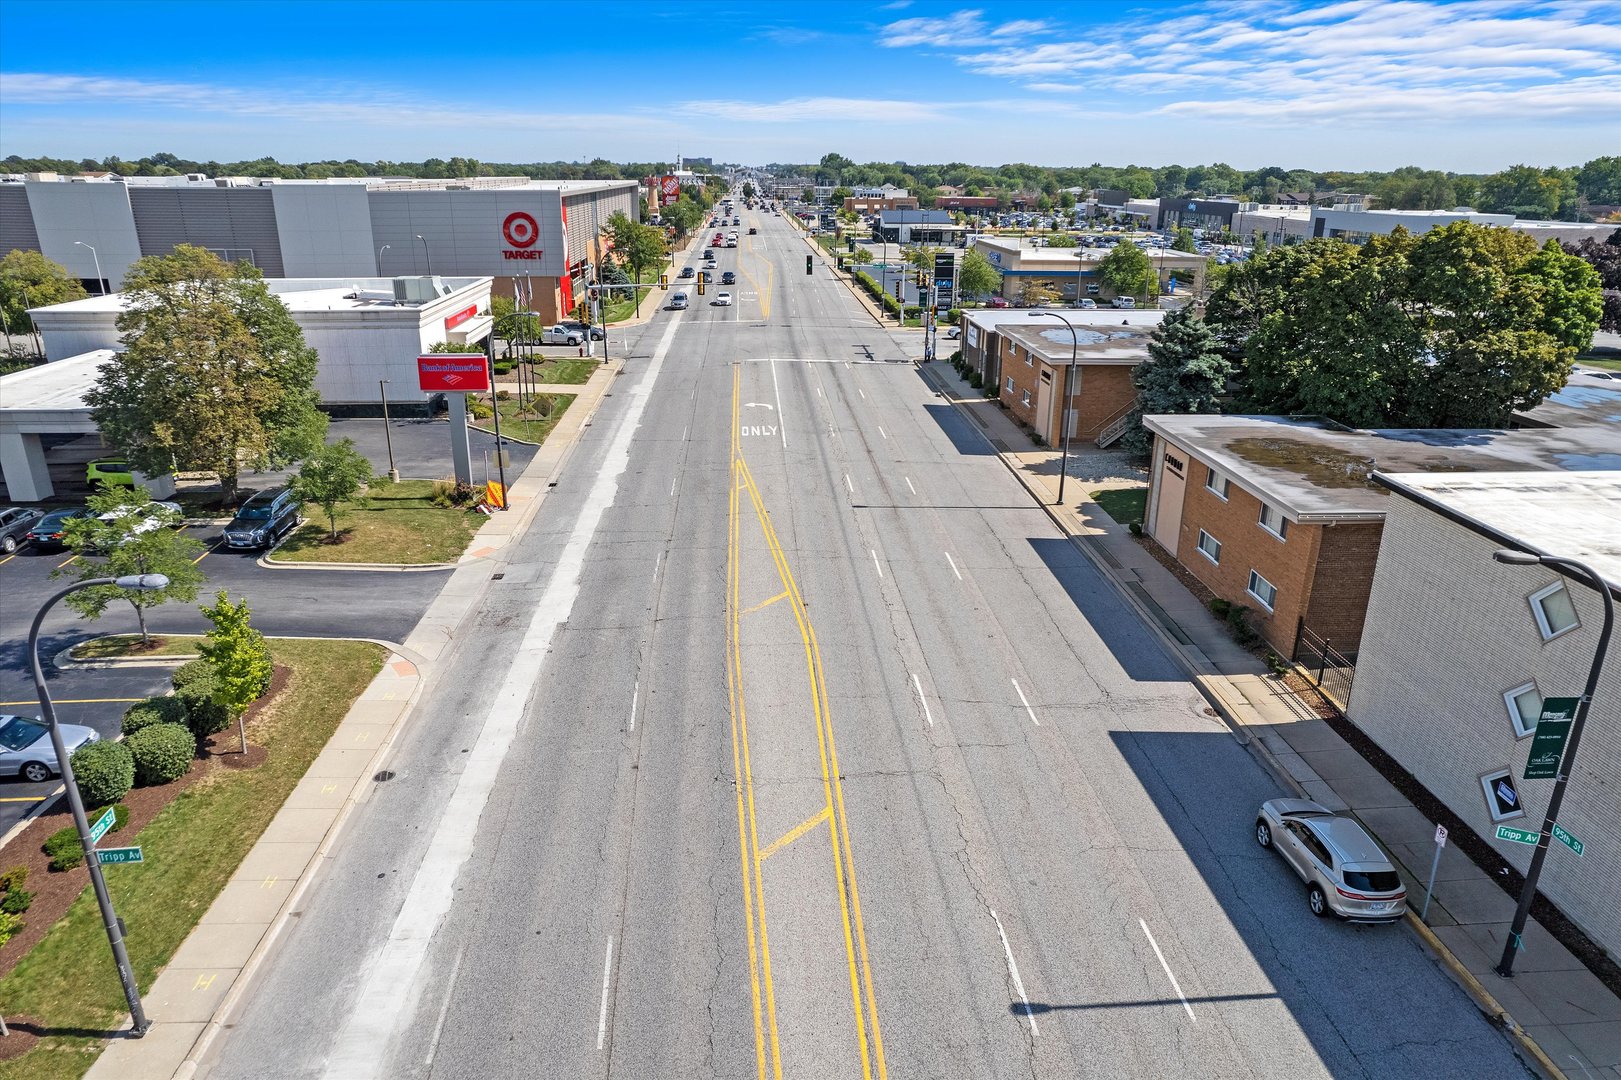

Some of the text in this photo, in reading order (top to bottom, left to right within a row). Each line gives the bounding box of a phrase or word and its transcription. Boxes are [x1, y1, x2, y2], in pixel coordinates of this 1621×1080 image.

[502, 250, 543, 260] TARGET
[421, 363, 441, 372] Bank
[450, 363, 483, 372] America
[741, 426, 777, 436] ONLY
[91, 813, 114, 840] 95th St
[1499, 827, 1538, 842] Tripp Av
[1555, 827, 1582, 853] 95th St
[98, 851, 140, 862] Tripp Av
